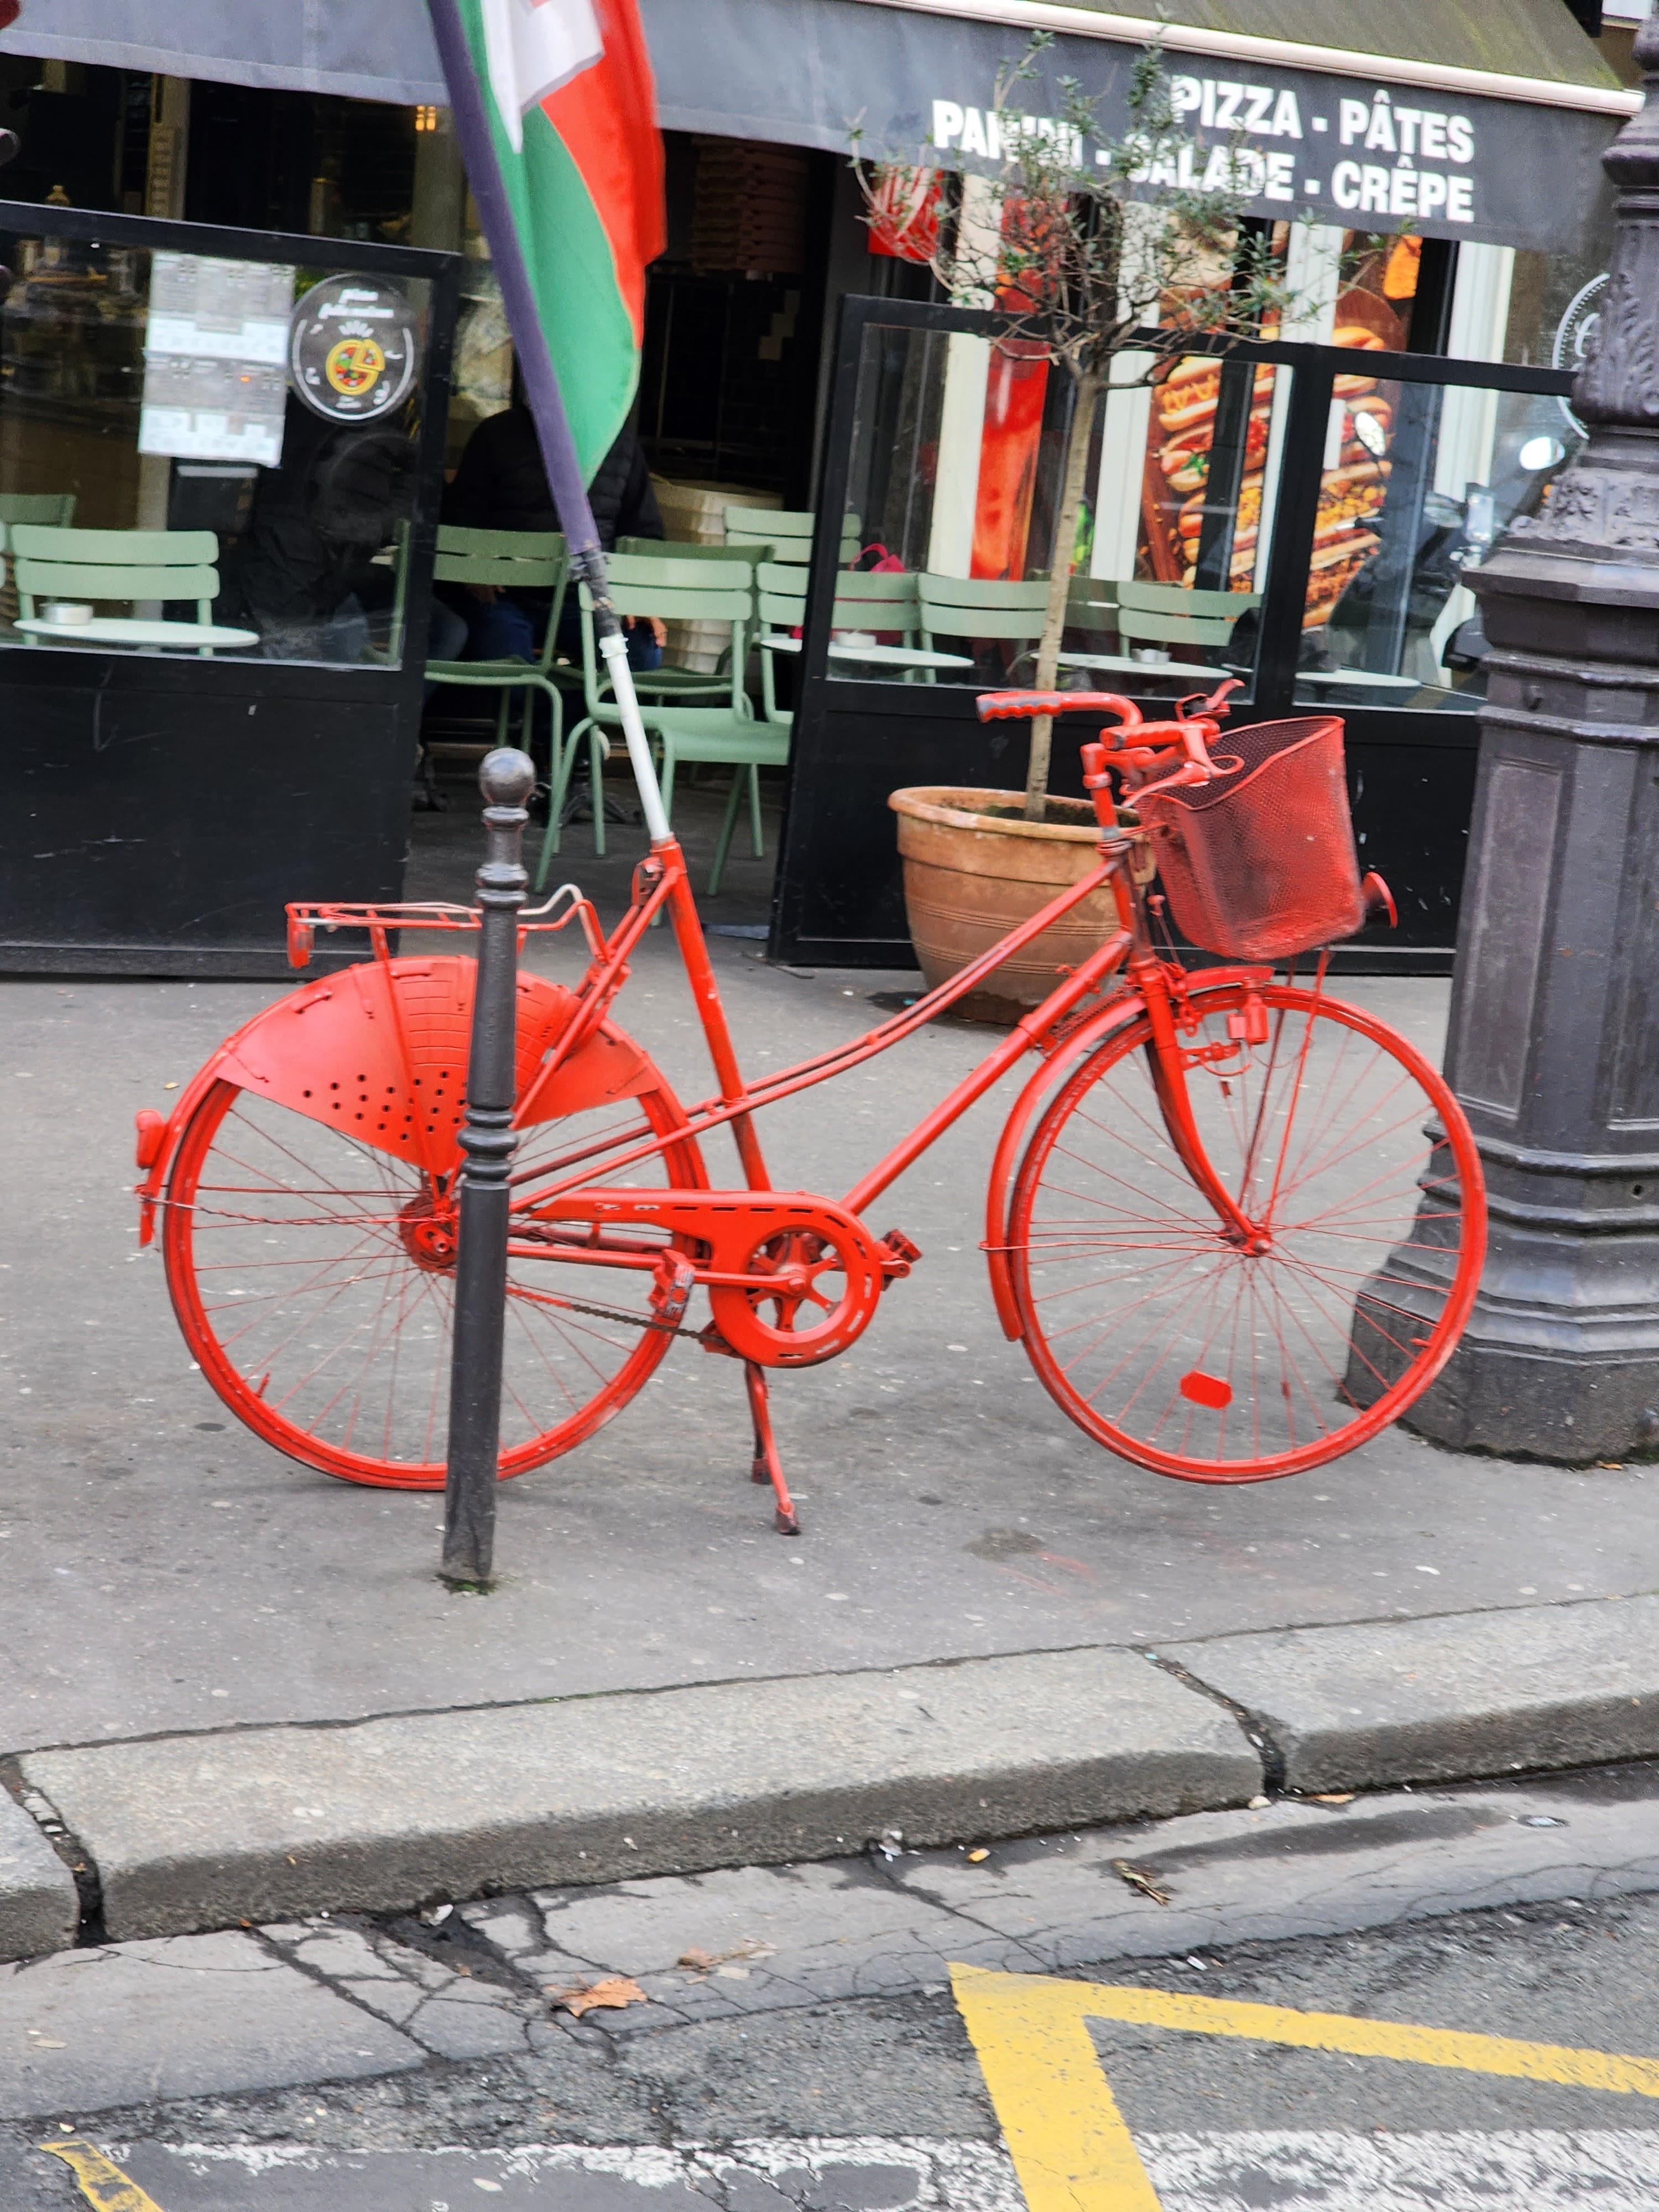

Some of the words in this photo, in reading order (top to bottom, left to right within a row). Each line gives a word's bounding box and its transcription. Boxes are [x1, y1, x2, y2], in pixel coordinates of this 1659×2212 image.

[1170, 74, 1303, 139] PIZZA
[1339, 89, 1475, 164] PÂTES
[1331, 154, 1475, 223] CRÊPE
